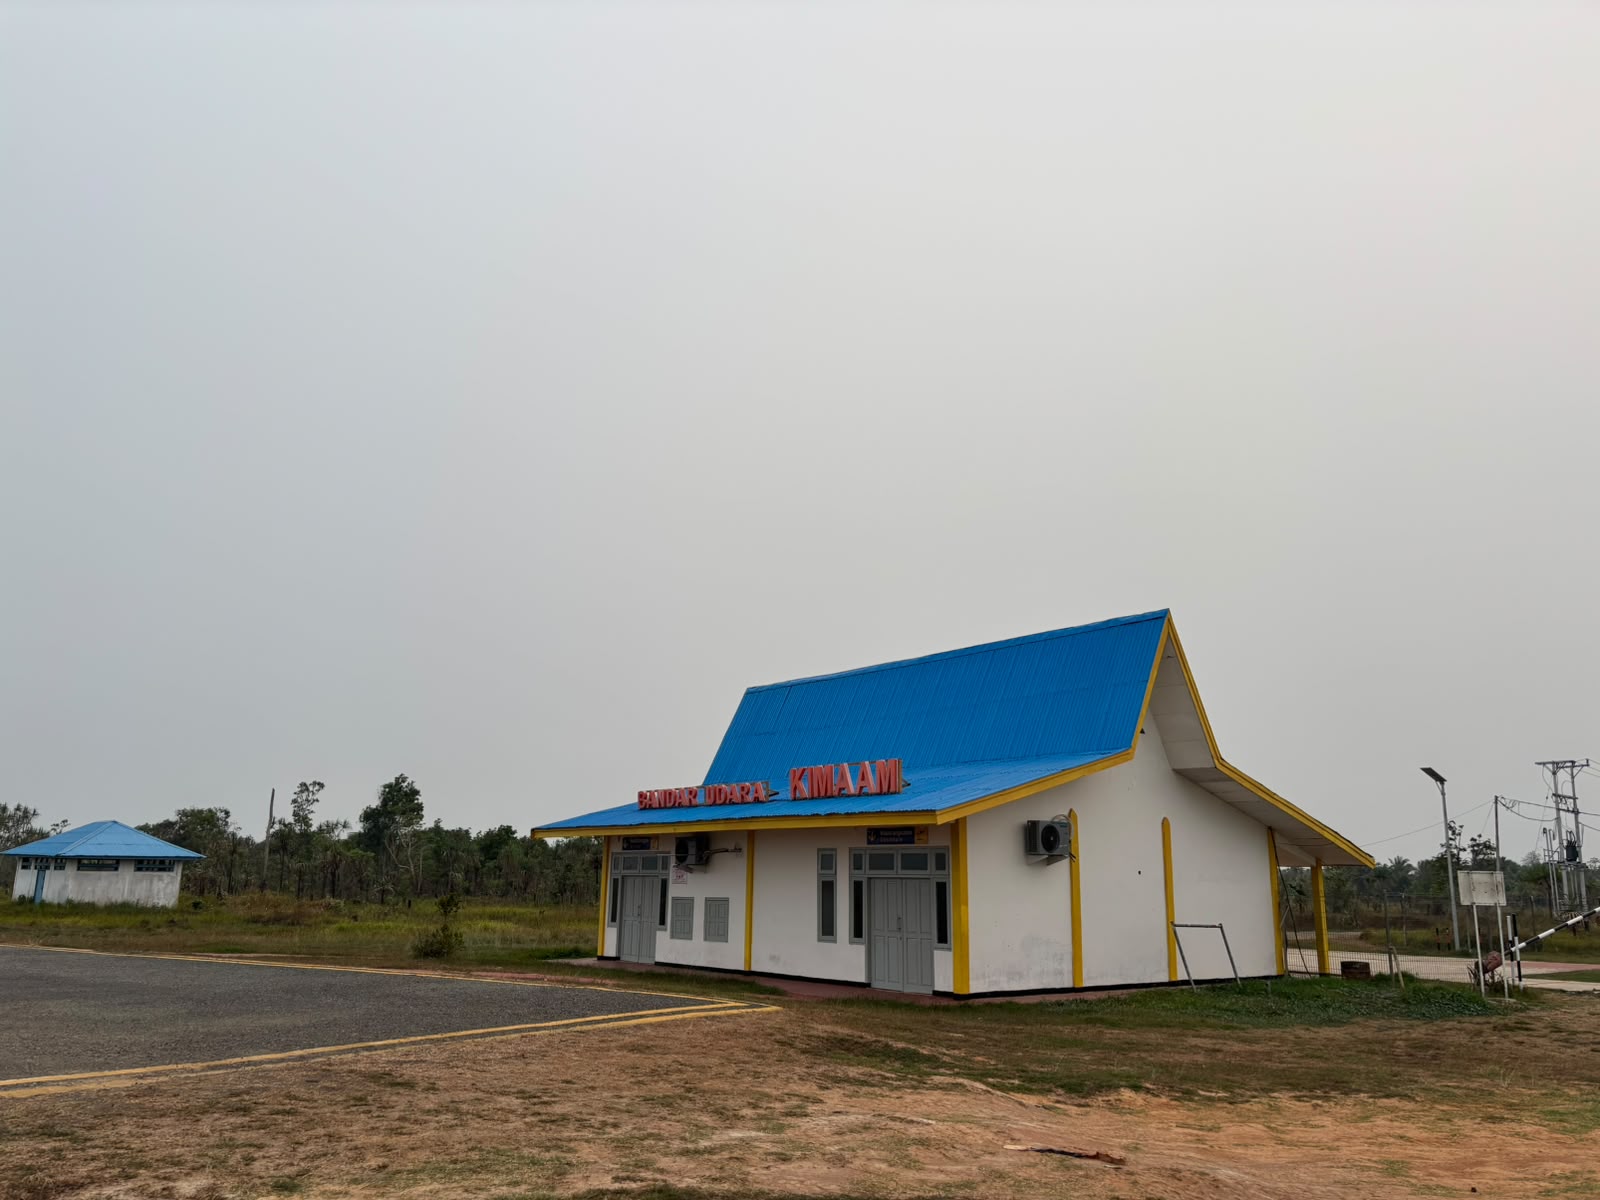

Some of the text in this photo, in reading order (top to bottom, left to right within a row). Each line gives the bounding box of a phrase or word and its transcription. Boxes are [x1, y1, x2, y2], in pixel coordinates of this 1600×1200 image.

[638, 759, 900, 810] BANDAR UDARA KIMAAM
